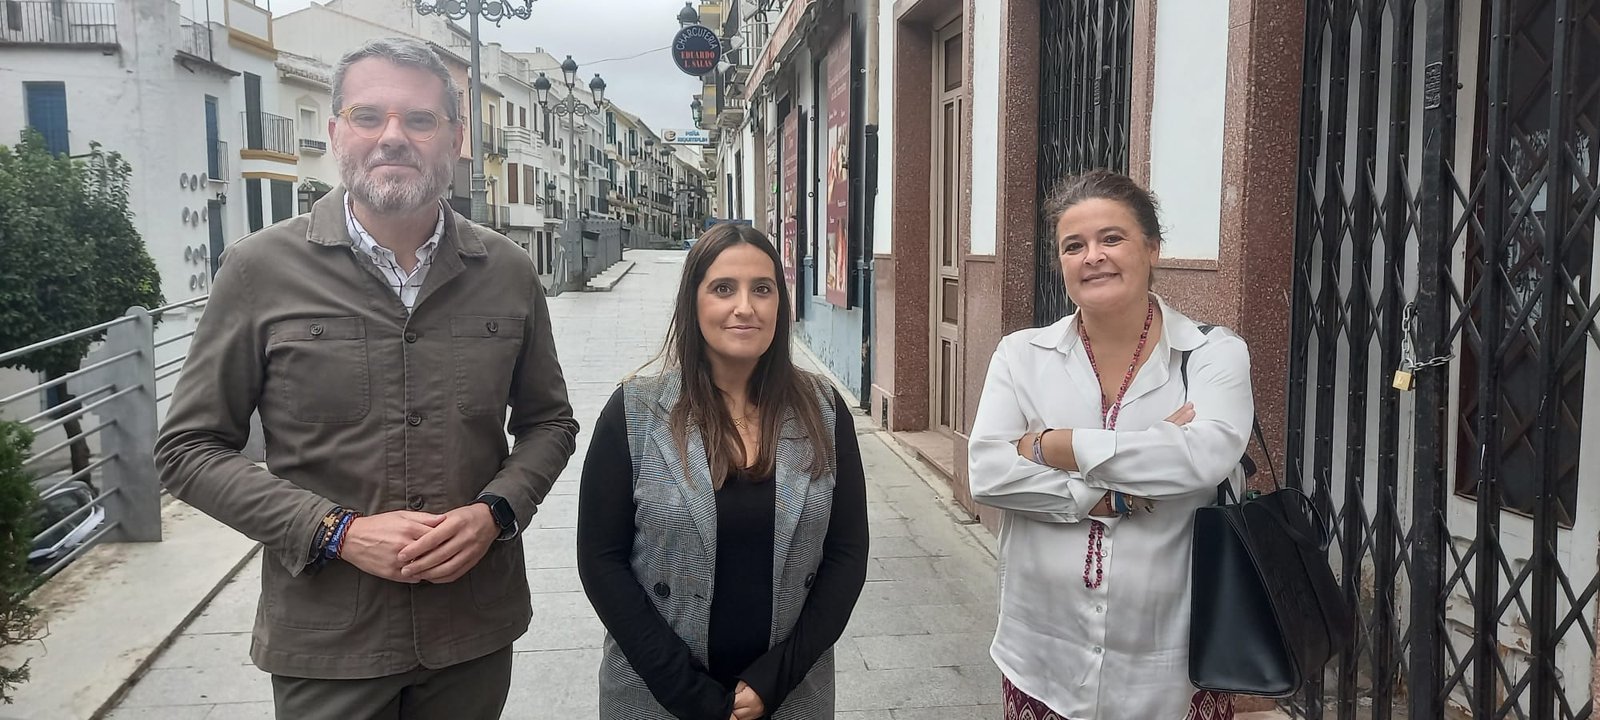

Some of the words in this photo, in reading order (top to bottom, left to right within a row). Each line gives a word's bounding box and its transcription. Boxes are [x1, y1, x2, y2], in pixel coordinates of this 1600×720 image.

[676, 27, 718, 50] CHARCUTERIA
[681, 50, 715, 59] EDUARDO
[691, 60, 713, 68] SALAS
